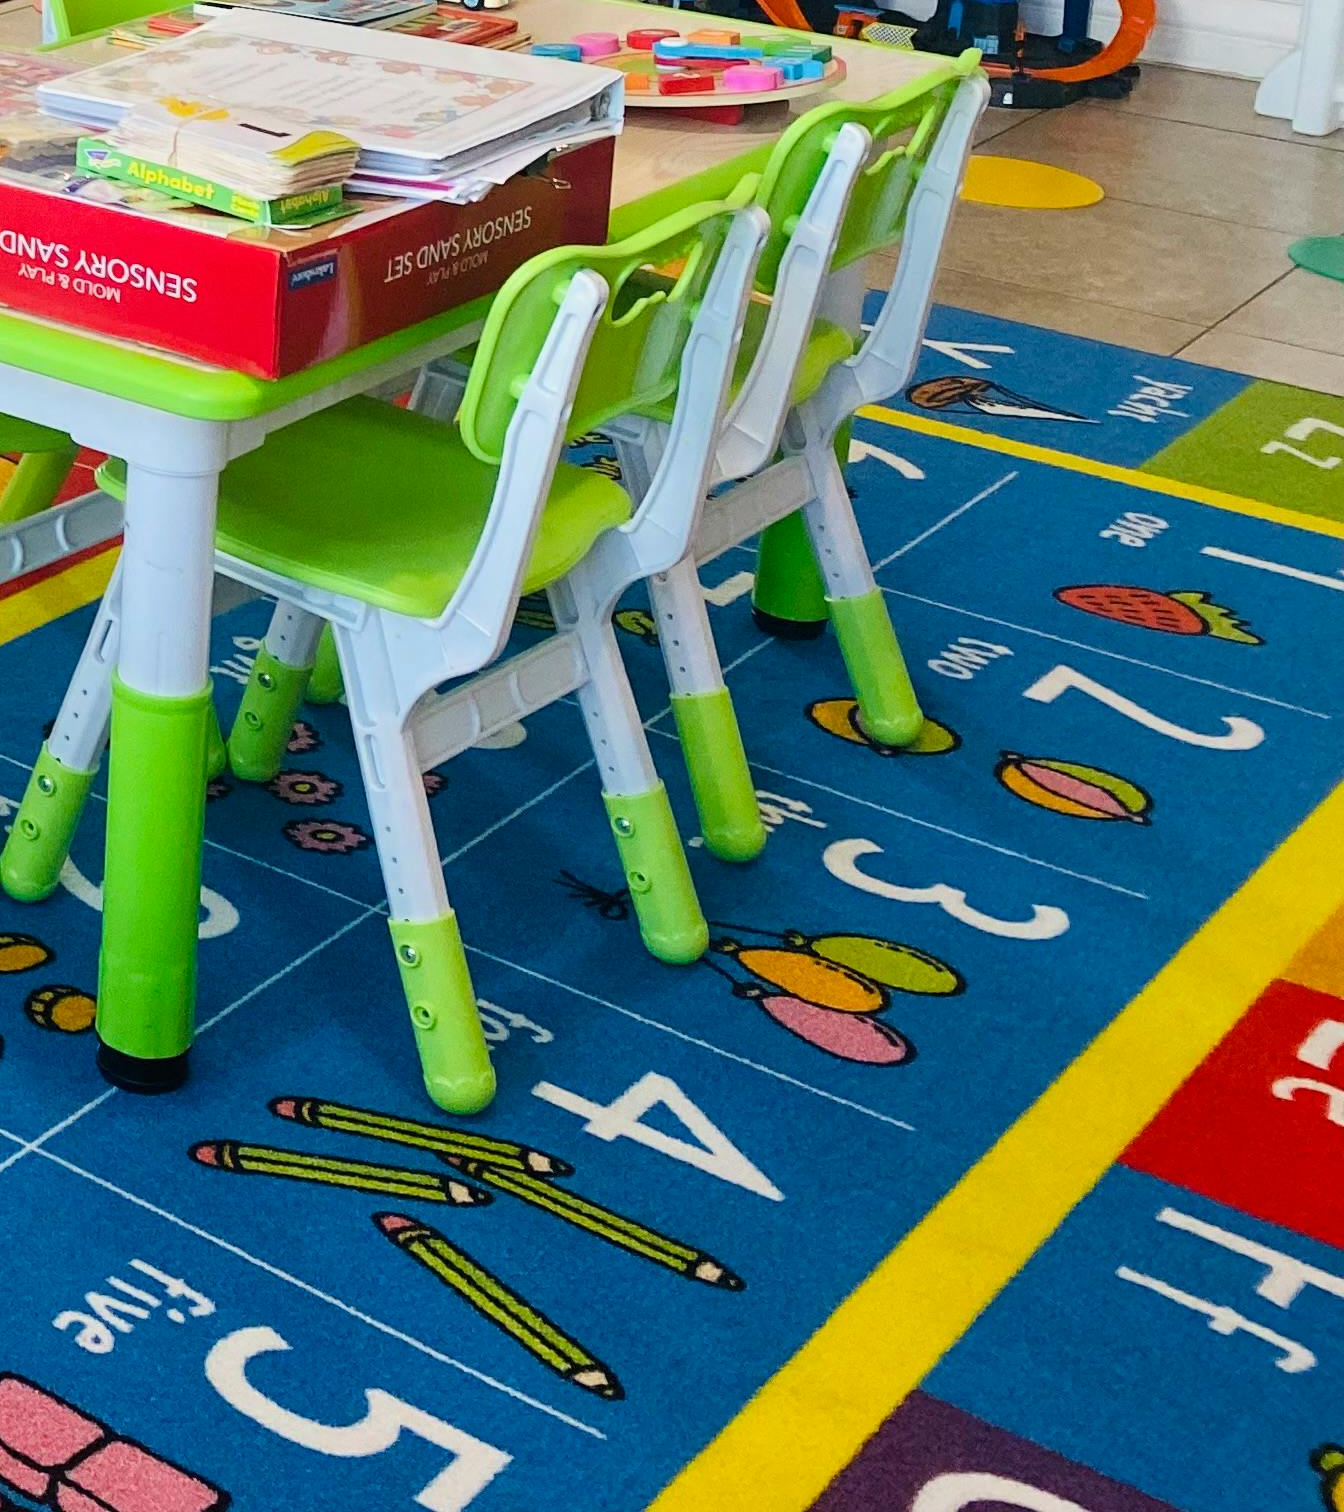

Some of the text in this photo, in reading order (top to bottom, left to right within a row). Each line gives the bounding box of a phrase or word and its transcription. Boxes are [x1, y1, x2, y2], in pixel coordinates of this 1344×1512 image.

[126, 162, 216, 200] Alphabet
[73, 249, 198, 304] SENSORY
[383, 205, 533, 284] SENSORY SAND SET
[18, 262, 121, 303] MOLD & PLAY
[1108, 374, 1195, 424] yacht
[1098, 510, 1172, 549] one
[927, 635, 1016, 681] two
[1022, 664, 1266, 752] 2
[821, 836, 1071, 942] 3
[530, 1070, 786, 1204] 4
[50, 1256, 218, 1355] five
[202, 1324, 517, 1512] 5
